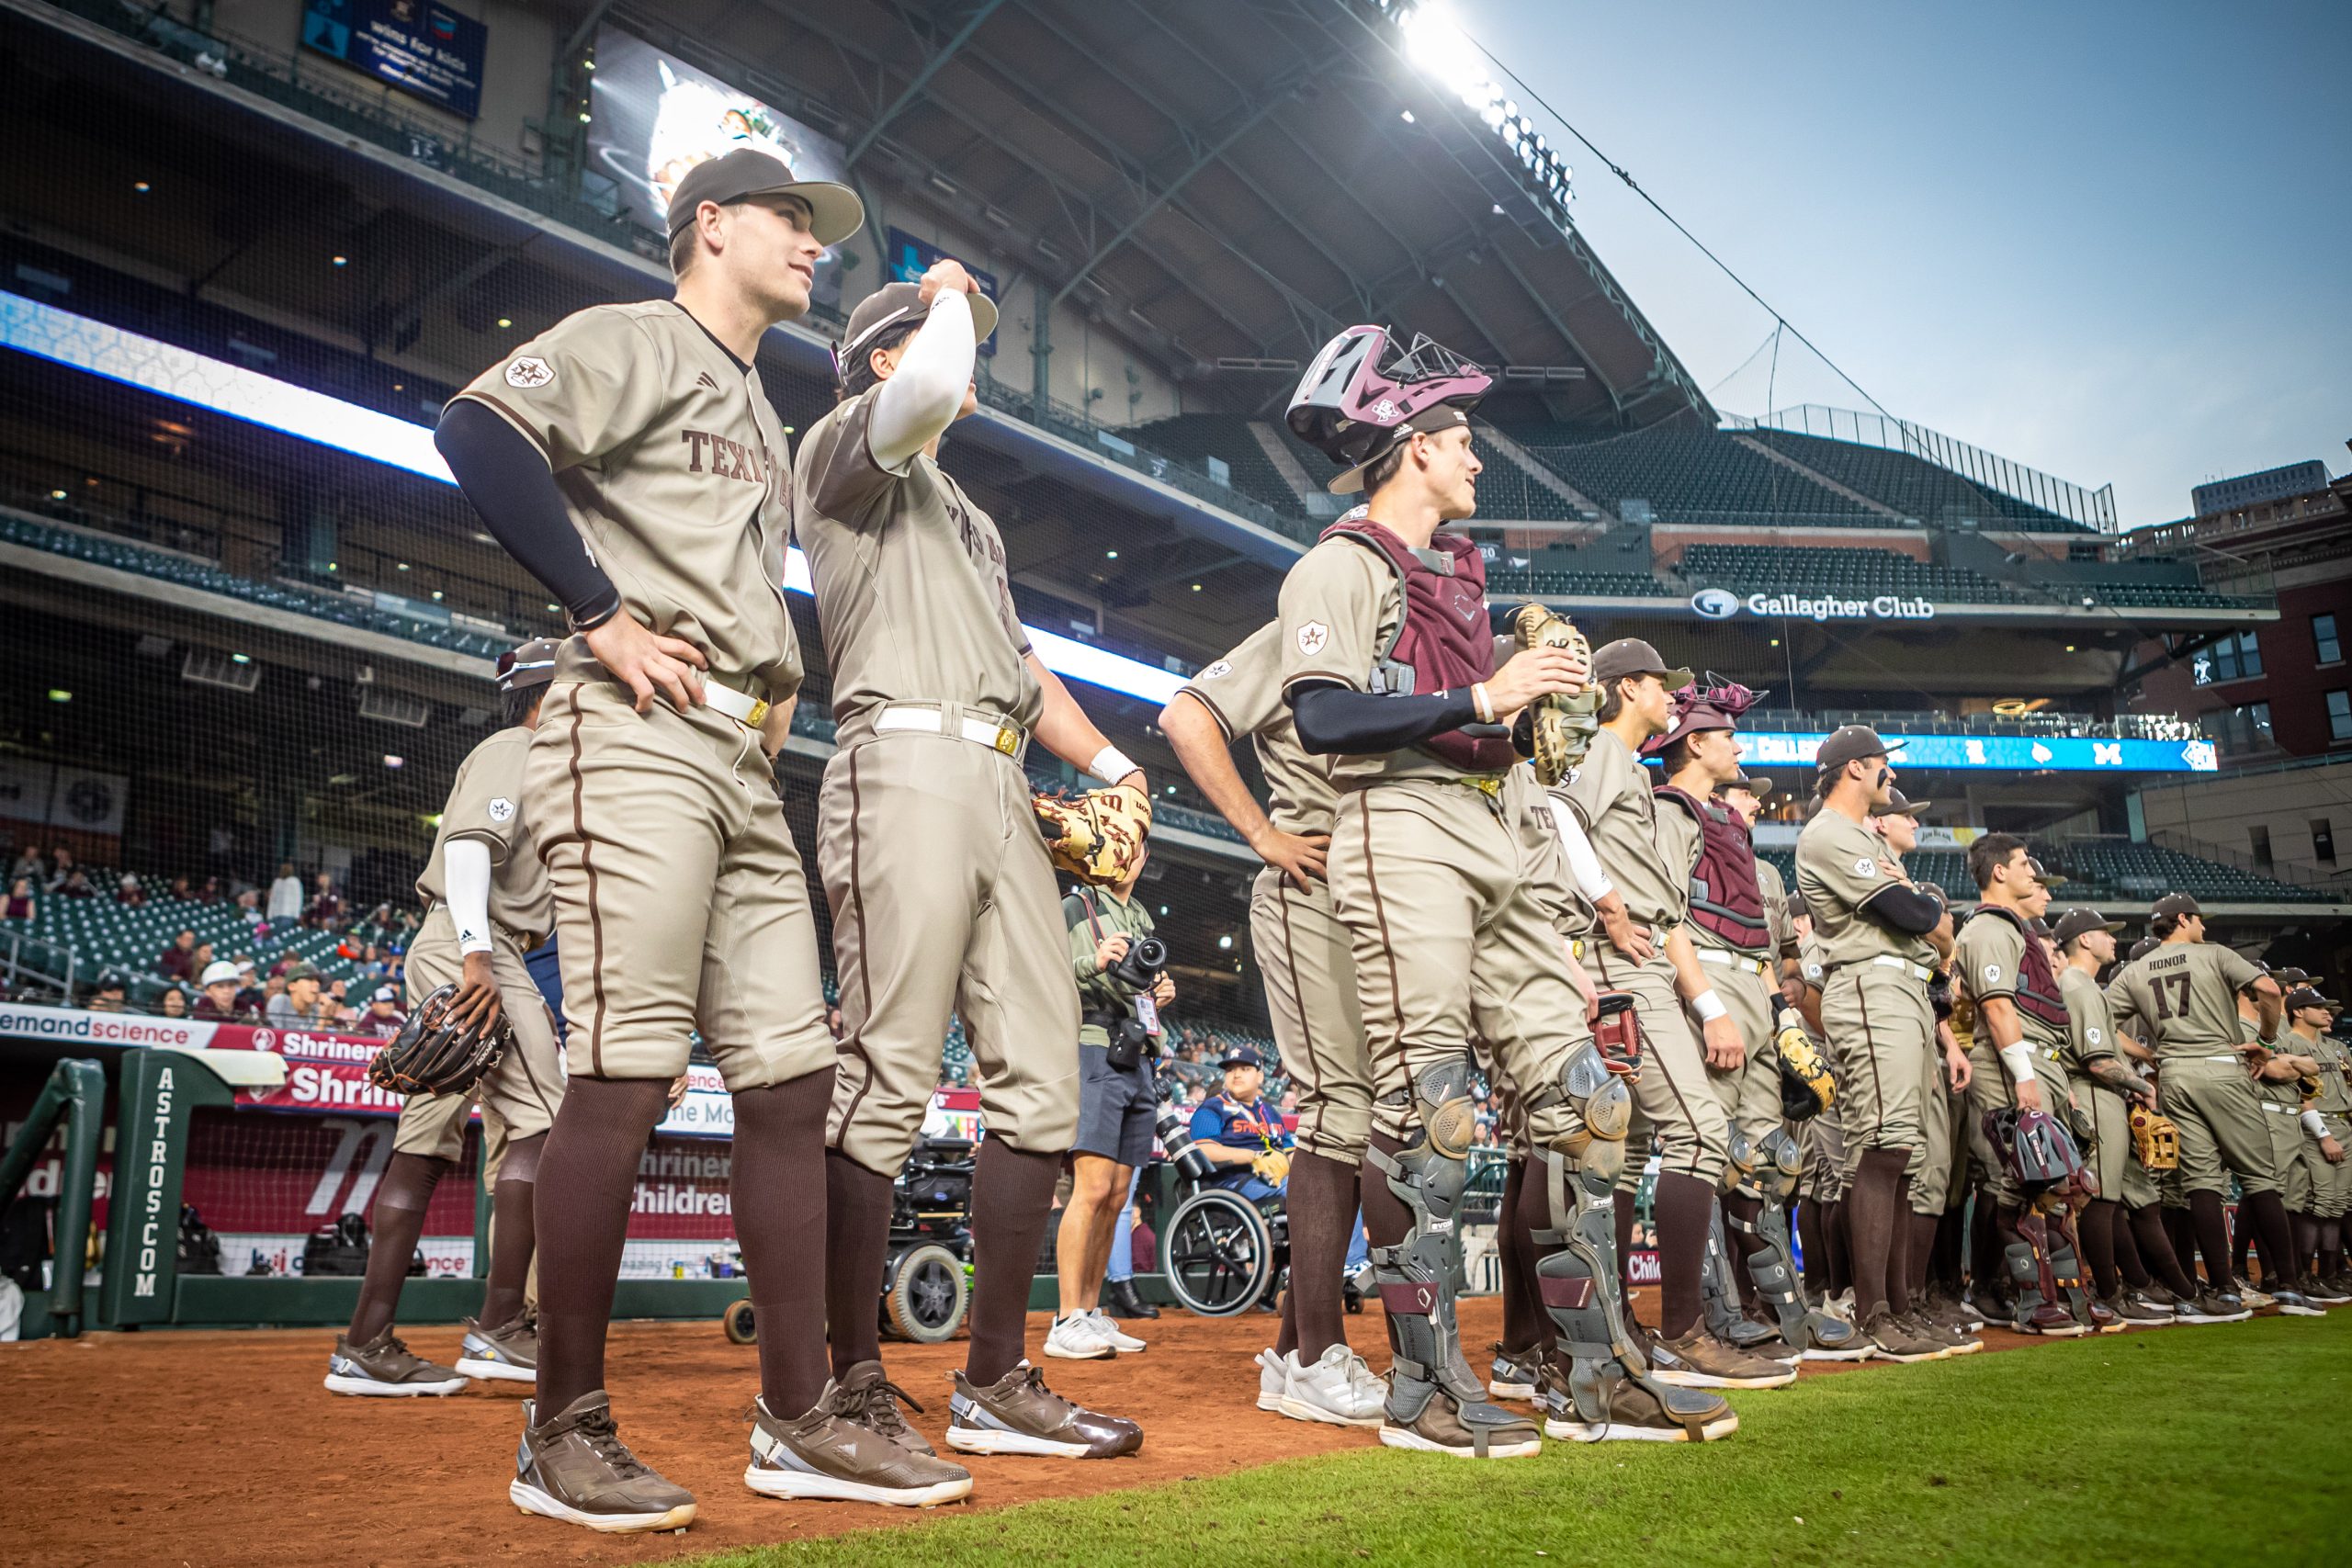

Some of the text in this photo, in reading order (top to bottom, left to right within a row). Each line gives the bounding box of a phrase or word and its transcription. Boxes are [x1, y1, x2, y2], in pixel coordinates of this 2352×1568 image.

[370, 20, 407, 45] wins
[410, 37, 434, 57] for
[435, 48, 467, 73] kids
[1747, 593, 1934, 621] Gallagher Club
[2093, 742, 2122, 764] M
[2149, 953, 2188, 971] HONOR
[2148, 971, 2191, 1021] 17
